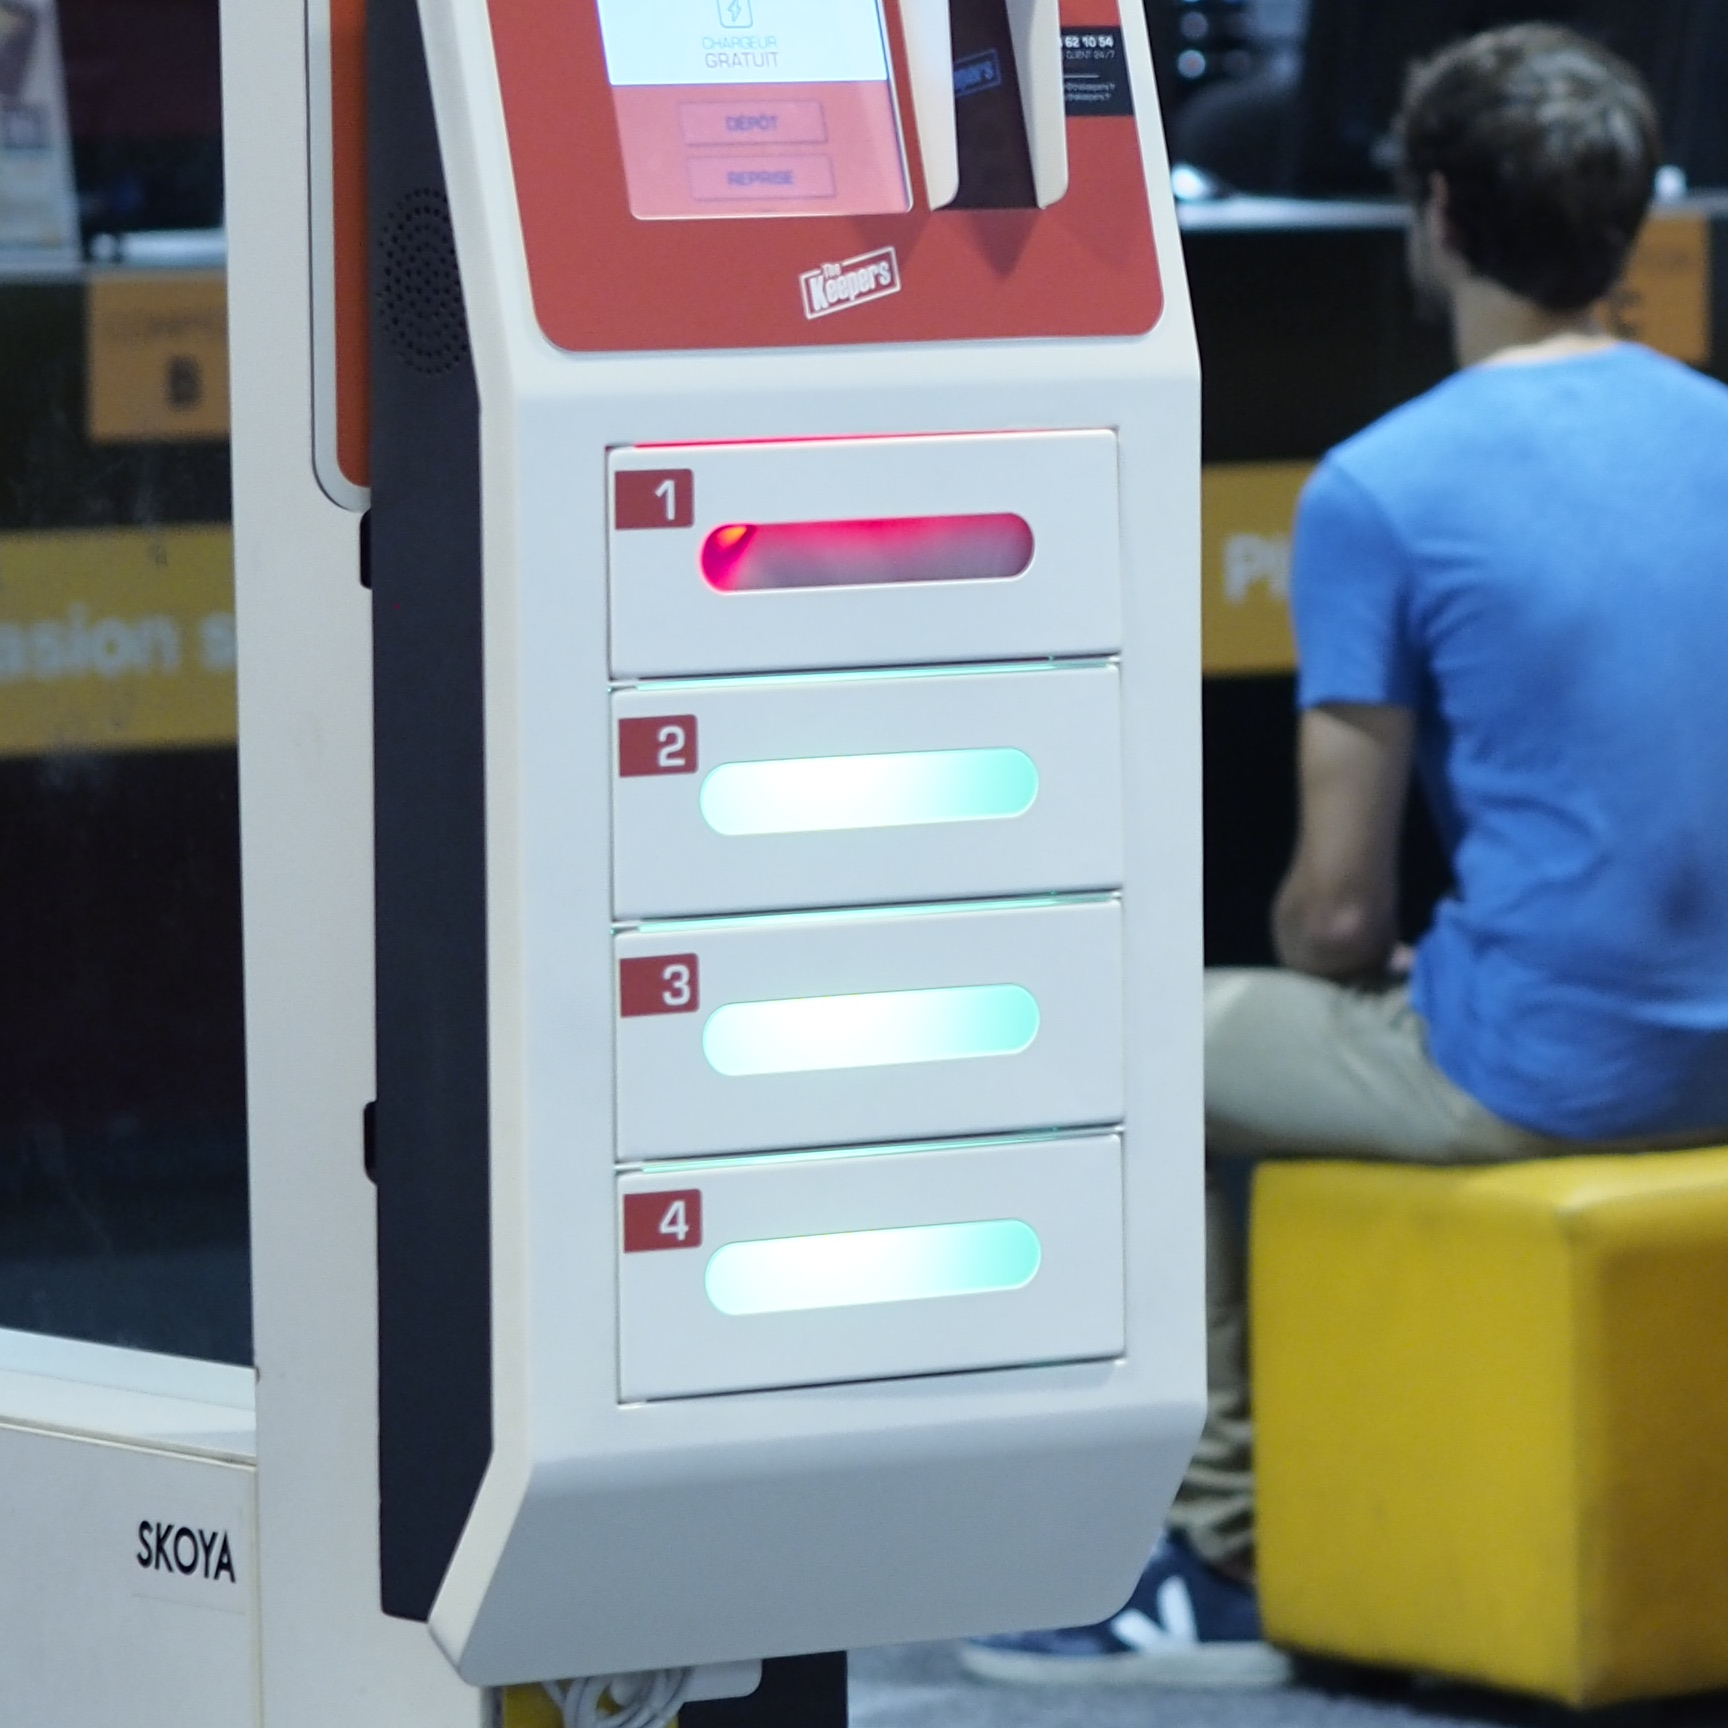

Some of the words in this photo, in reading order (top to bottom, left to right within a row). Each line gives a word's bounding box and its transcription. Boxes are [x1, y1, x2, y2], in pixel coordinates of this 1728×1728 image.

[702, 35, 777, 50] CHARGEUR
[705, 51, 779, 69] GRATUIT
[809, 261, 891, 311] Keepers
[654, 479, 677, 522] 1
[657, 725, 686, 768] 2
[661, 964, 691, 1007] 3
[658, 1200, 689, 1242] 4
[136, 1519, 237, 1584] SKOYA
